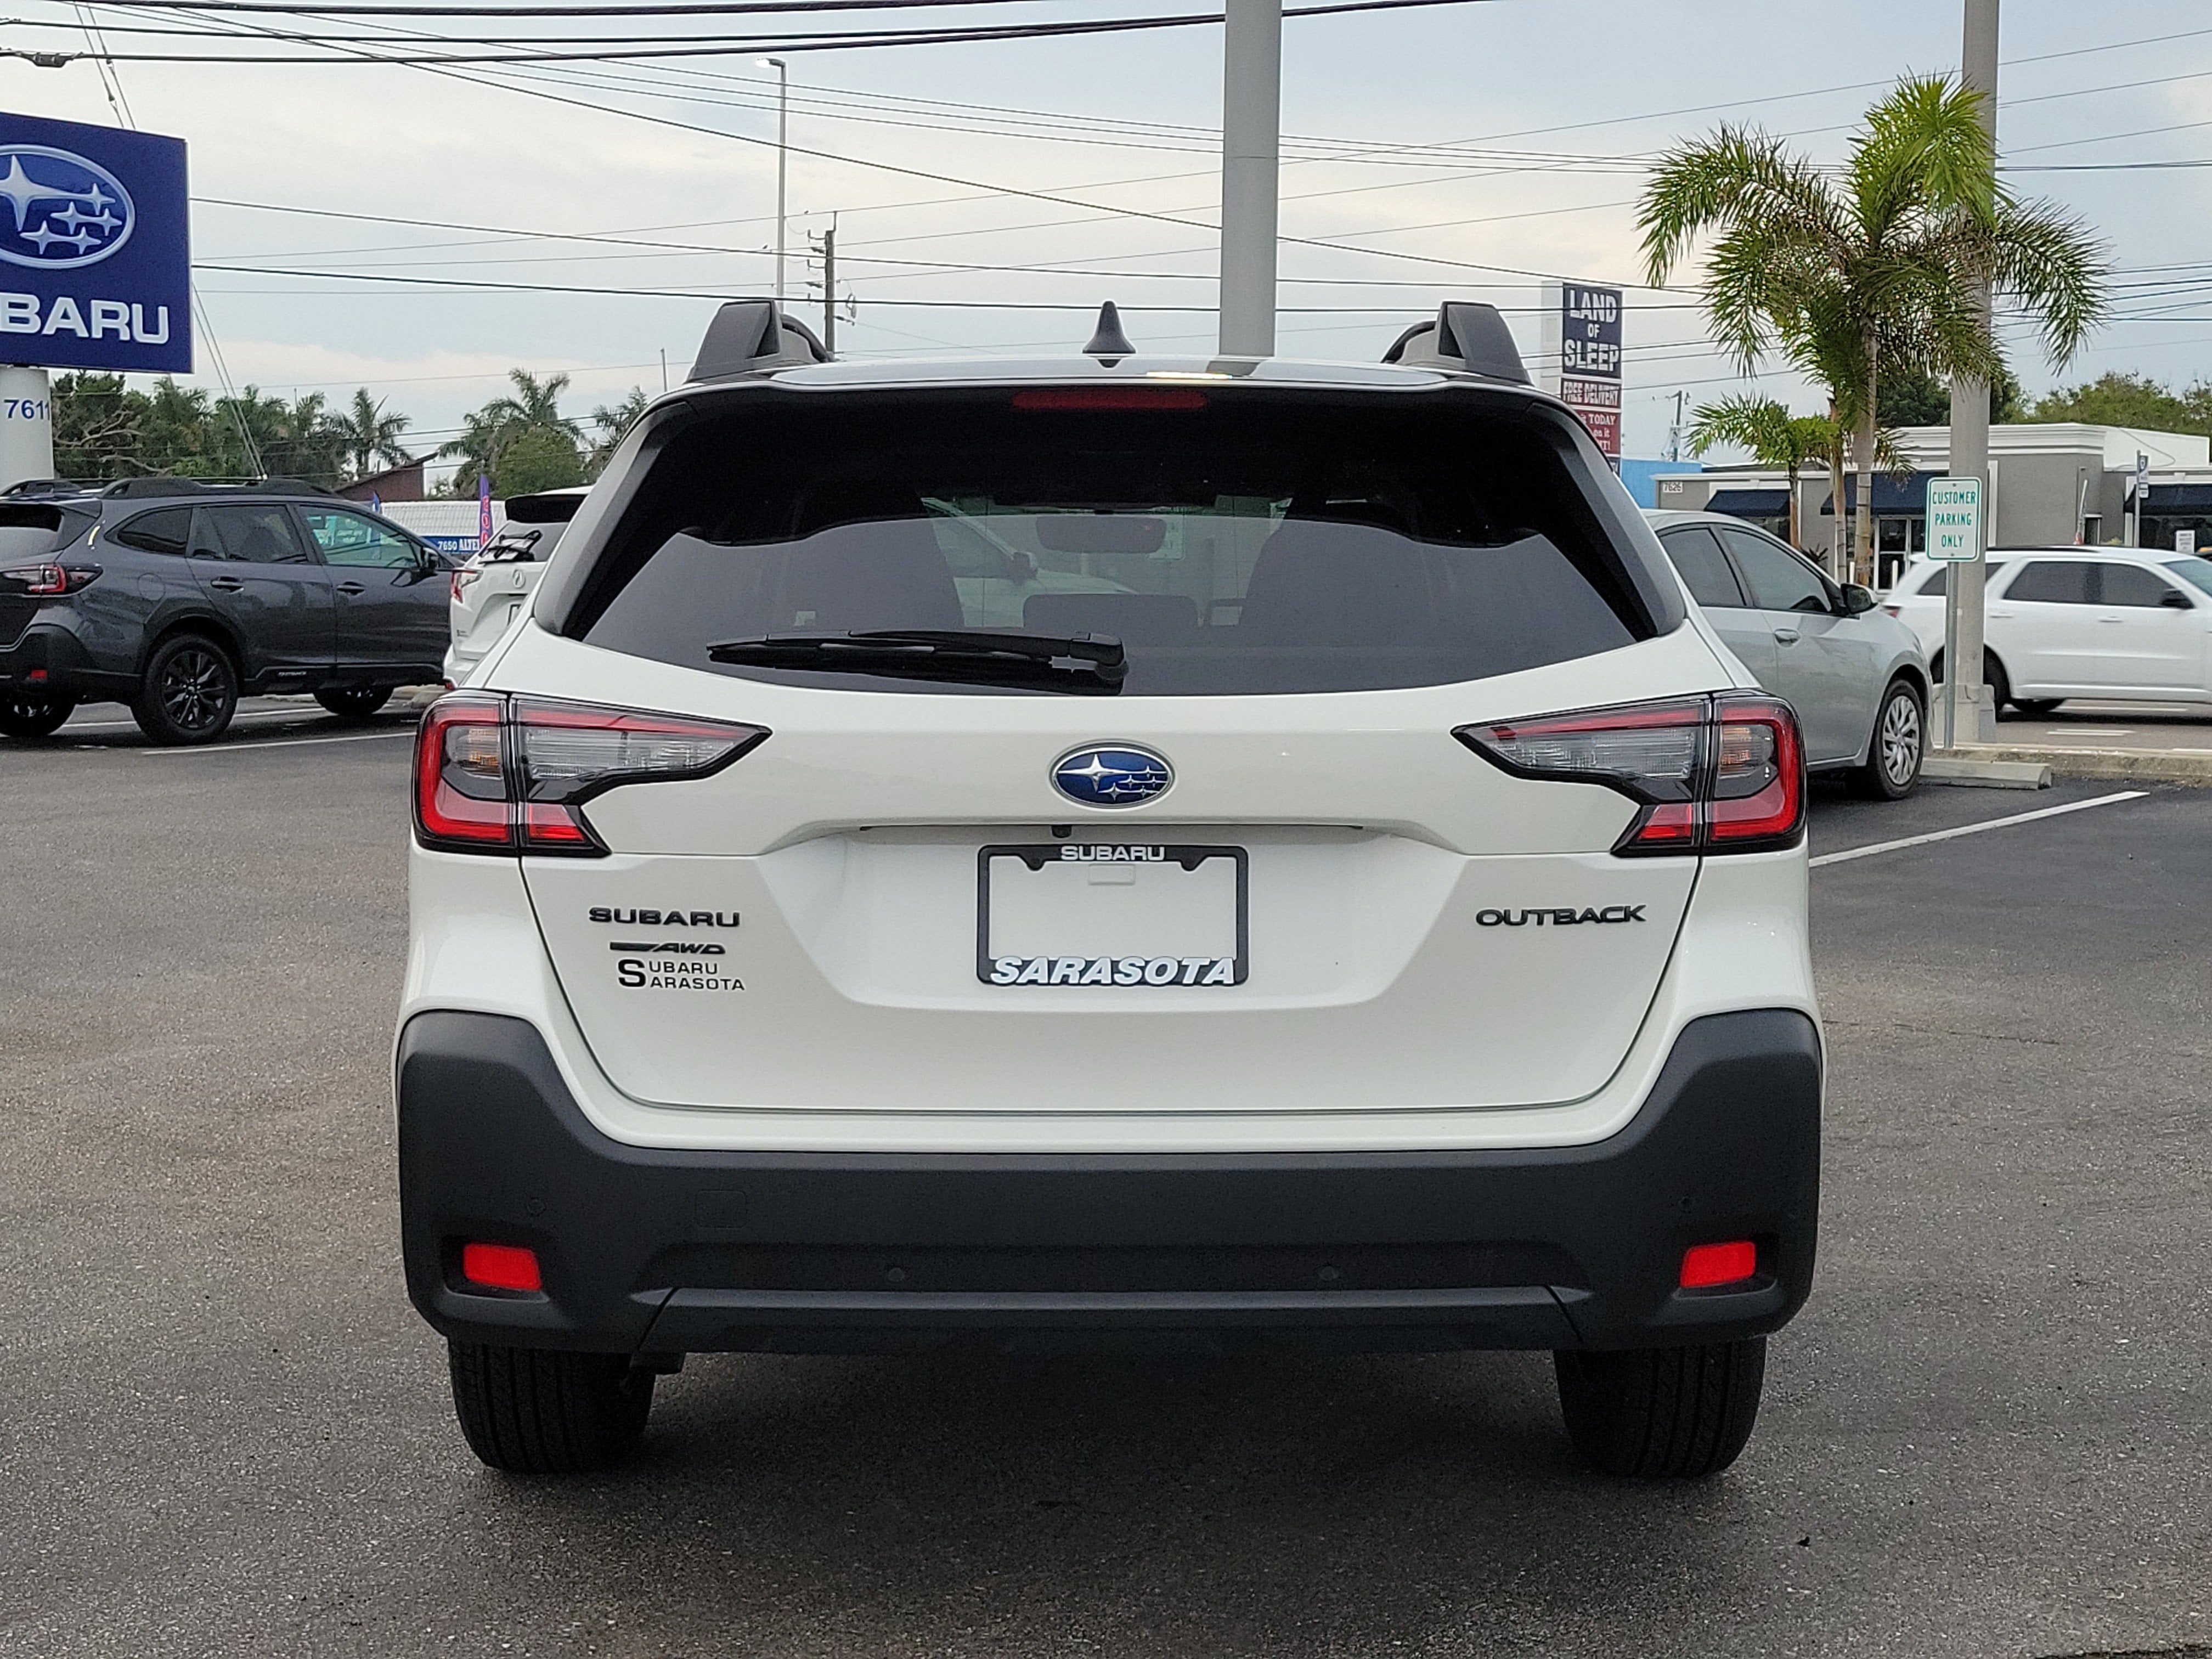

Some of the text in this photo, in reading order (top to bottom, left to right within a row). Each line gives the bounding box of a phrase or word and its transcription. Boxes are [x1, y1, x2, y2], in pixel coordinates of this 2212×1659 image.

[1570, 289, 1617, 323] LAND
[1588, 323, 1600, 338] OF
[1564, 338, 1619, 371] SLEEP
[1564, 381, 1619, 406] FREE DELIVERY
[4, 399, 50, 421] 7611
[1588, 414, 1616, 425] TODAY
[1932, 492, 1976, 505] CUSTOMER
[1935, 512, 1972, 526] PARKING
[1941, 534, 1964, 548] ONLY
[1060, 845, 1165, 861] SUBARU
[589, 907, 740, 928] SUBARU
[1475, 904, 1647, 926] OUTBACK
[652, 942, 726, 955] AWD
[990, 956, 1235, 986] SARASOTA
